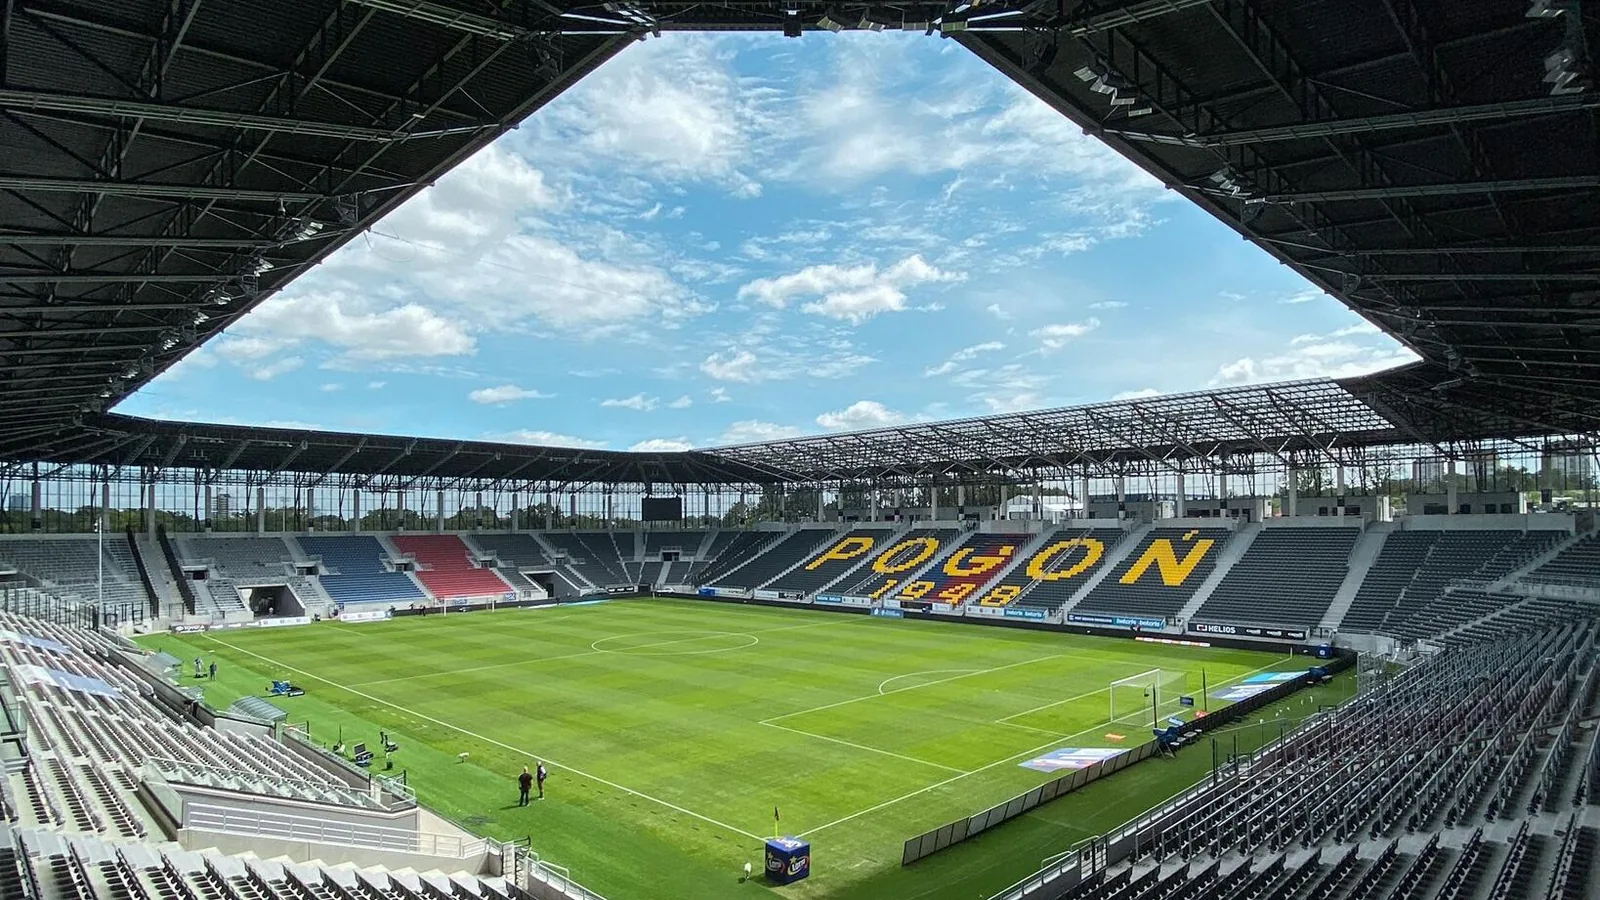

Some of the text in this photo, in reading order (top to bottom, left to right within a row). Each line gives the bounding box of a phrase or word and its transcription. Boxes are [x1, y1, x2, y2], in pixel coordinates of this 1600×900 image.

[806, 530, 1215, 586] POGOŃ
[868, 579, 1021, 607] 1948
[1208, 625, 1236, 634] HELIOS
